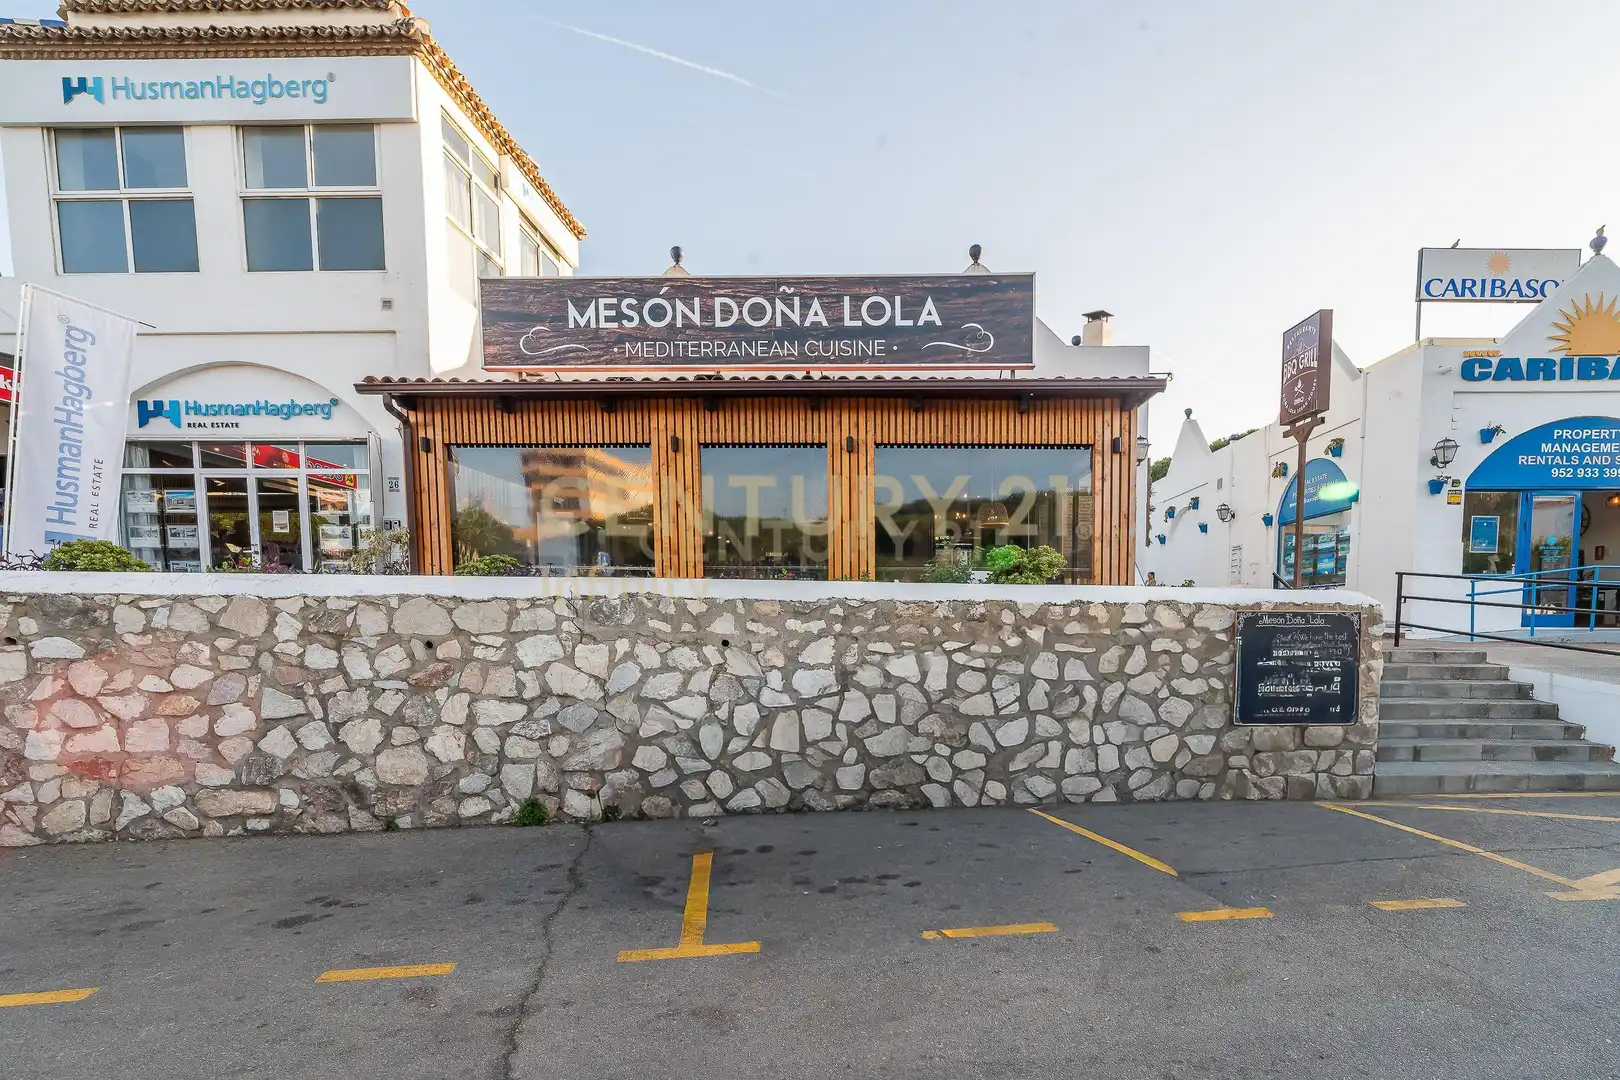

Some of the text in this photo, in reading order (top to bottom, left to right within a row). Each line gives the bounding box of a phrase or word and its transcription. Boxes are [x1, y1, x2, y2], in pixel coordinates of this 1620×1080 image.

[1424, 277, 1564, 299] CARIBASO
[567, 285, 943, 329] MESÓN DOÑA LOLA
[625, 340, 886, 358] MEDITERRANEAN CUISINE
[1283, 346, 1318, 385] BBQ GRILL
[1553, 429, 1620, 440] PROPERT
[1518, 455, 1580, 466] RENTALS
[1582, 455, 1611, 465] AND
[1551, 467, 1574, 478] 952
[1576, 467, 1599, 478] 933
[88, 457, 104, 529] REAL ESTATE
[388, 480, 400, 489] 26
